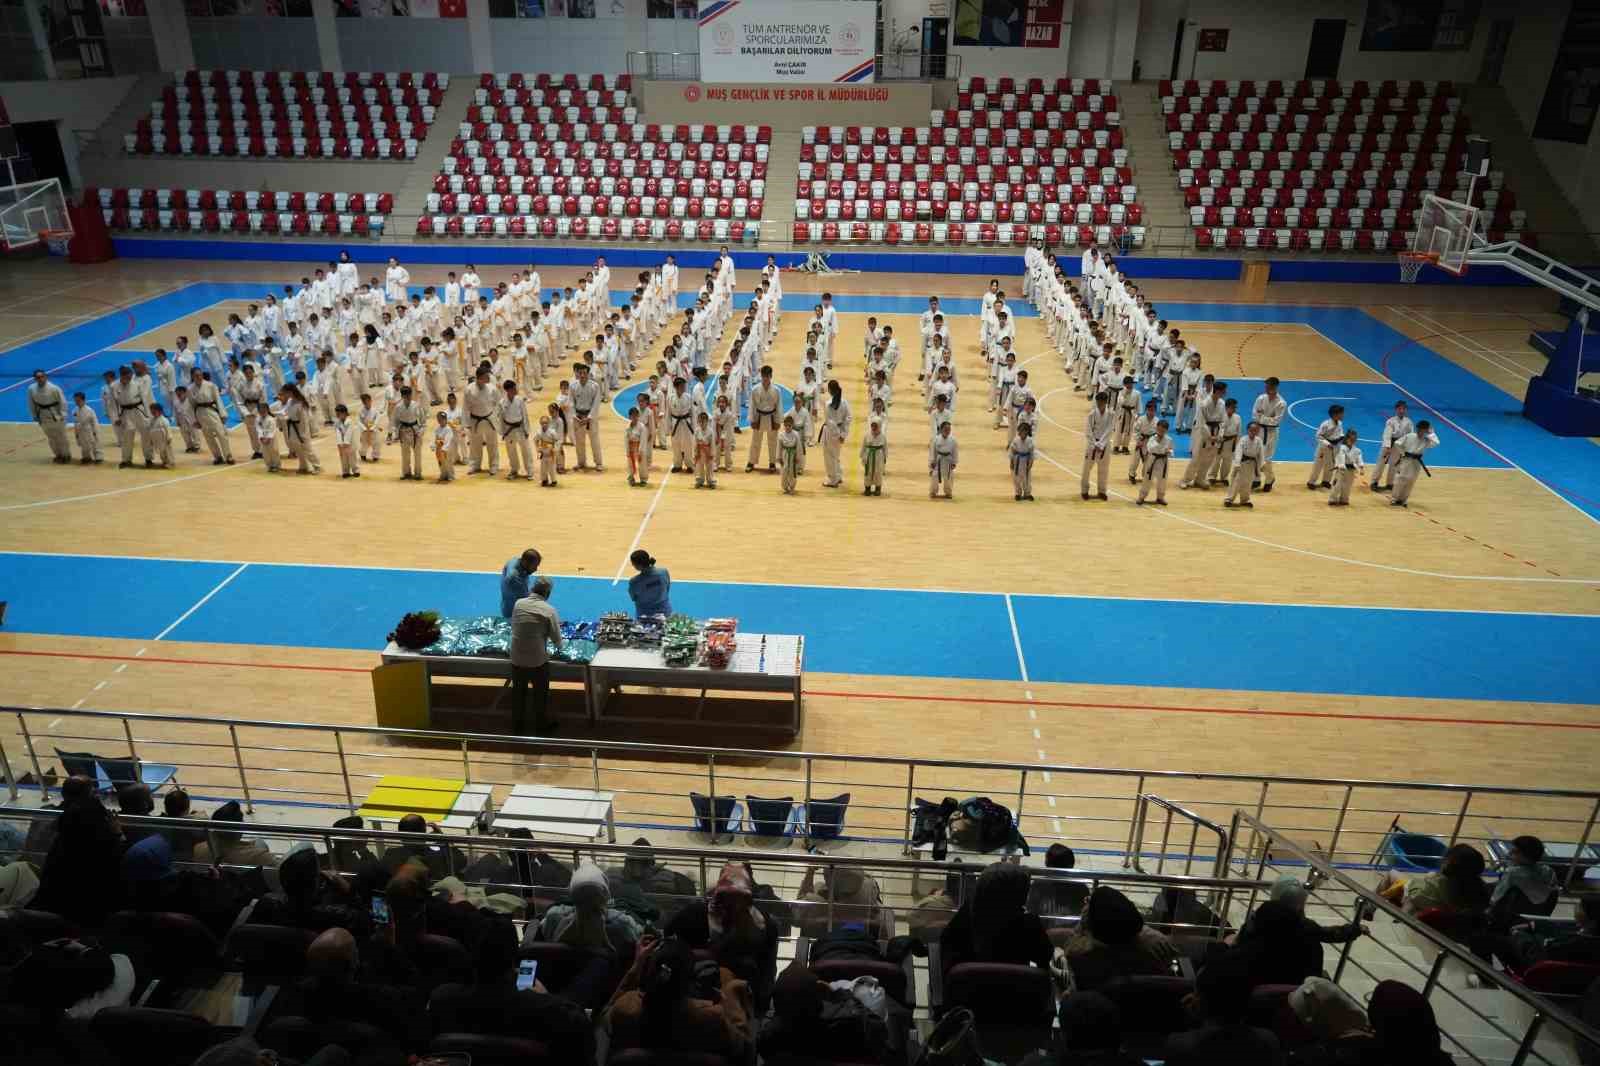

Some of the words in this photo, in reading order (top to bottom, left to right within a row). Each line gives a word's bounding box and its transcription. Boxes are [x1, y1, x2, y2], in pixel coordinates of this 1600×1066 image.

[743, 23, 764, 34] TÜM
[766, 23, 817, 34] ANTRENÖR
[819, 24, 831, 34] VE
[745, 35, 828, 45] SPORCULARIMIZA
[741, 47, 786, 56] BAŞARILAR
[787, 46, 832, 55] DİLİYORUM
[706, 88, 727, 102] MUŞ
[730, 87, 769, 102] GENÇLİK
[774, 88, 785, 100] VE
[789, 88, 814, 100] SPOR
[817, 87, 825, 100] İL
[829, 86, 889, 101] MÜDÜRLÜĞÜ
